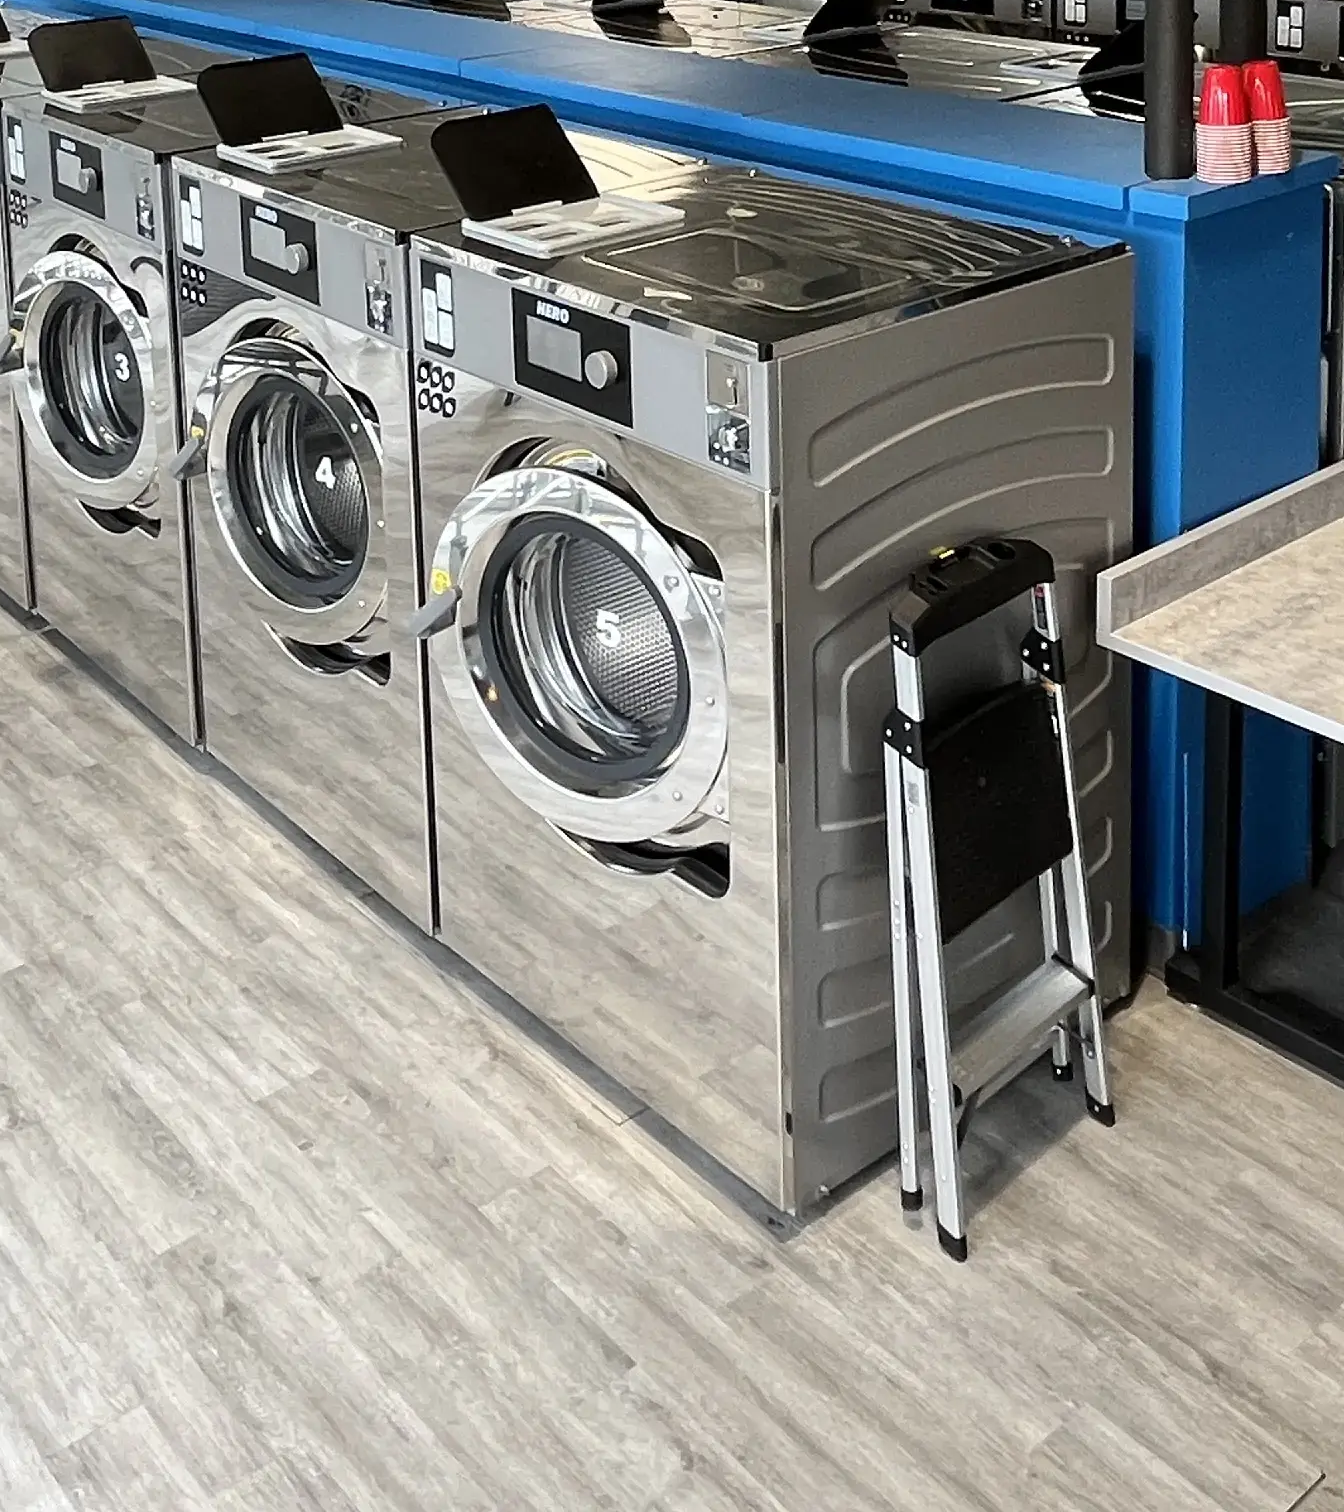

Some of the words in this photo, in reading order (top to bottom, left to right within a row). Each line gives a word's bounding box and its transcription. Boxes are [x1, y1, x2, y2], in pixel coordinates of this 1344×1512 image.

[535, 300, 570, 325] HERO
[114, 352, 130, 382] 3
[315, 456, 337, 489] 4
[596, 608, 622, 648] 5
